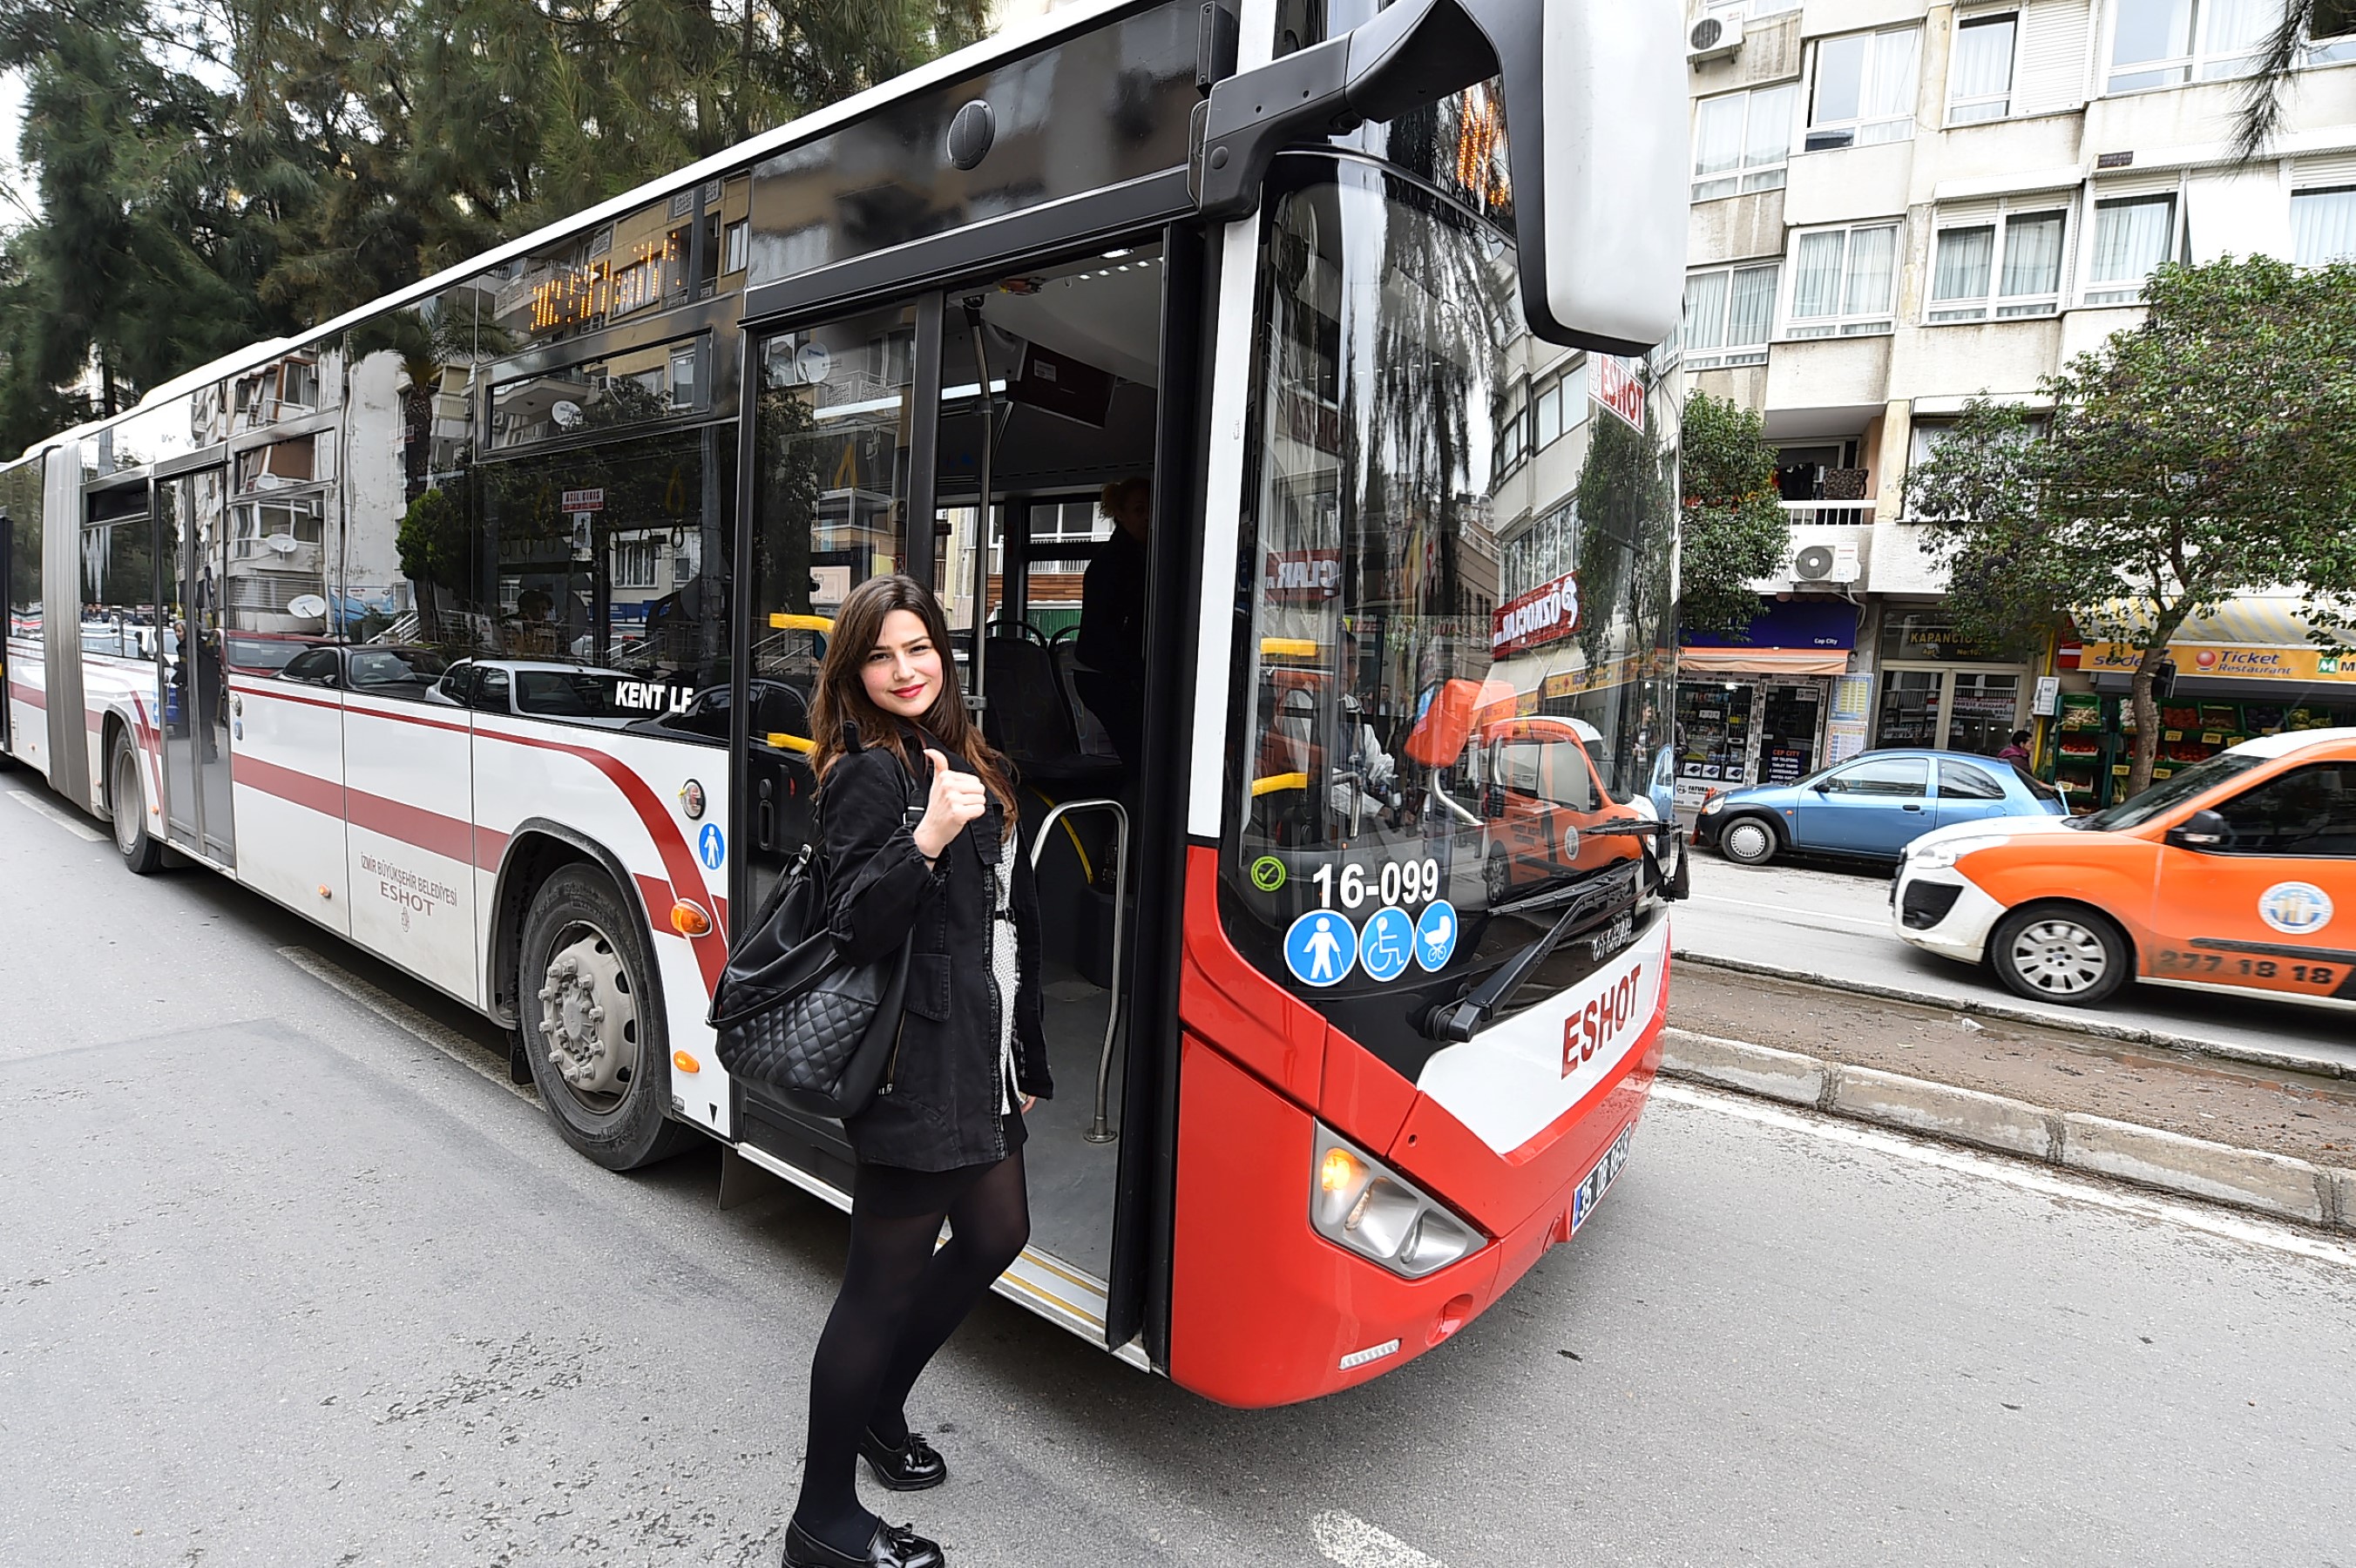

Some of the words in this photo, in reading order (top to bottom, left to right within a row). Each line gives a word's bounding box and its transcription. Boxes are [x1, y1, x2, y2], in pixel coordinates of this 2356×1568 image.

[2217, 663, 2292, 675] Restaurant
[2221, 650, 2280, 665] Ticket
[615, 680, 666, 710] KENT
[669, 686, 694, 713] LF
[380, 881, 435, 916] ESHOT
[1312, 858, 1439, 909] 16-099
[2159, 950, 2224, 972] 277
[2238, 958, 2278, 978] 18
[2292, 964, 2334, 985] 18
[1561, 963, 1642, 1080] ESHOT
[1580, 1177, 1594, 1219] 35
